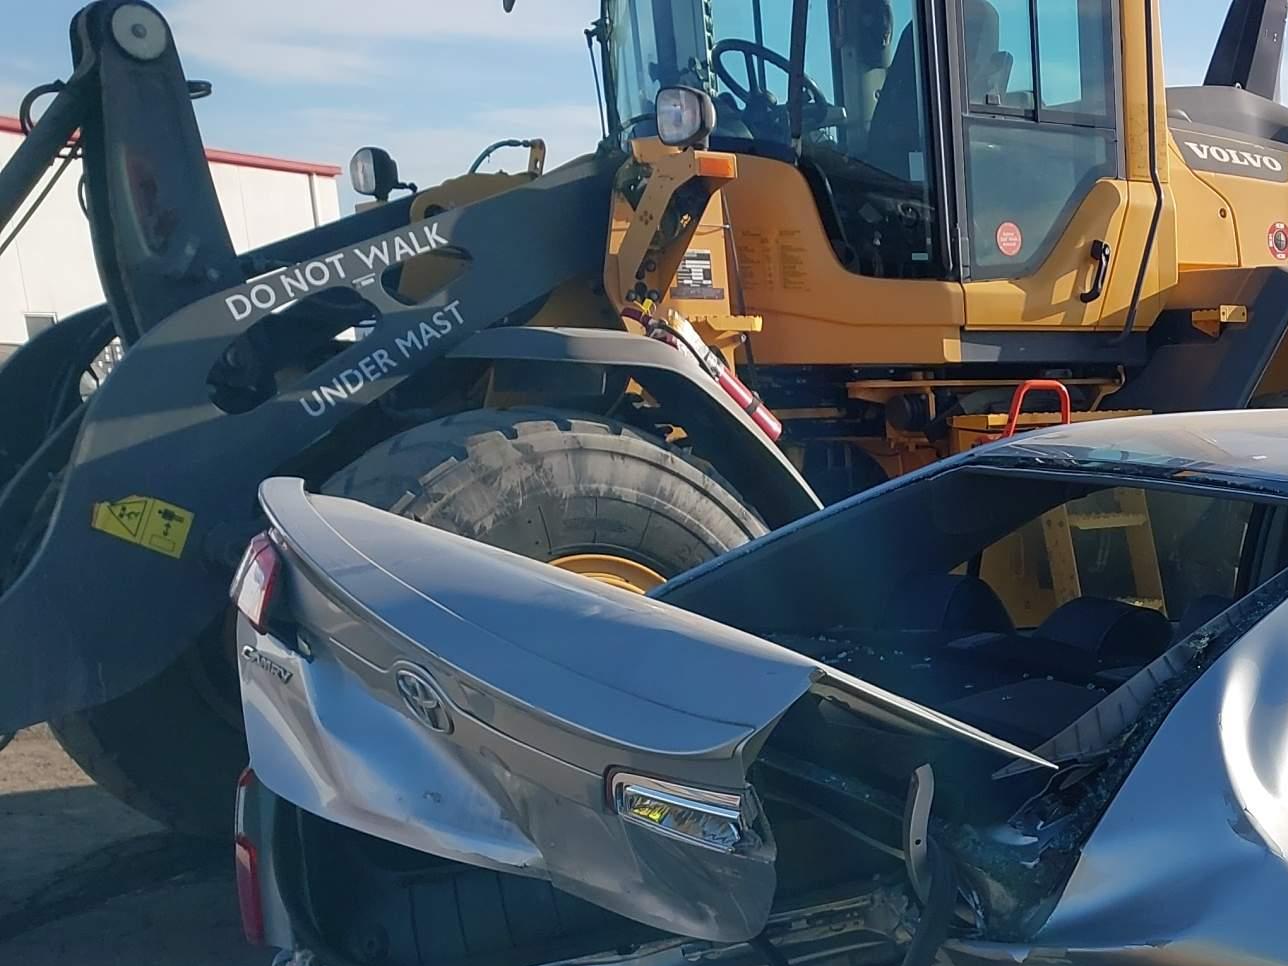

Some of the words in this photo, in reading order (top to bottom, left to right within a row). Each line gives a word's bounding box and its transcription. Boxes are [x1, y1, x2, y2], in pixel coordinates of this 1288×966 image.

[1184, 141, 1282, 171] VOLVO
[225, 284, 276, 321] DO
[280, 253, 346, 298] NOT
[354, 222, 449, 269] WALK
[299, 349, 397, 417] UNDER
[395, 300, 464, 358] MAST
